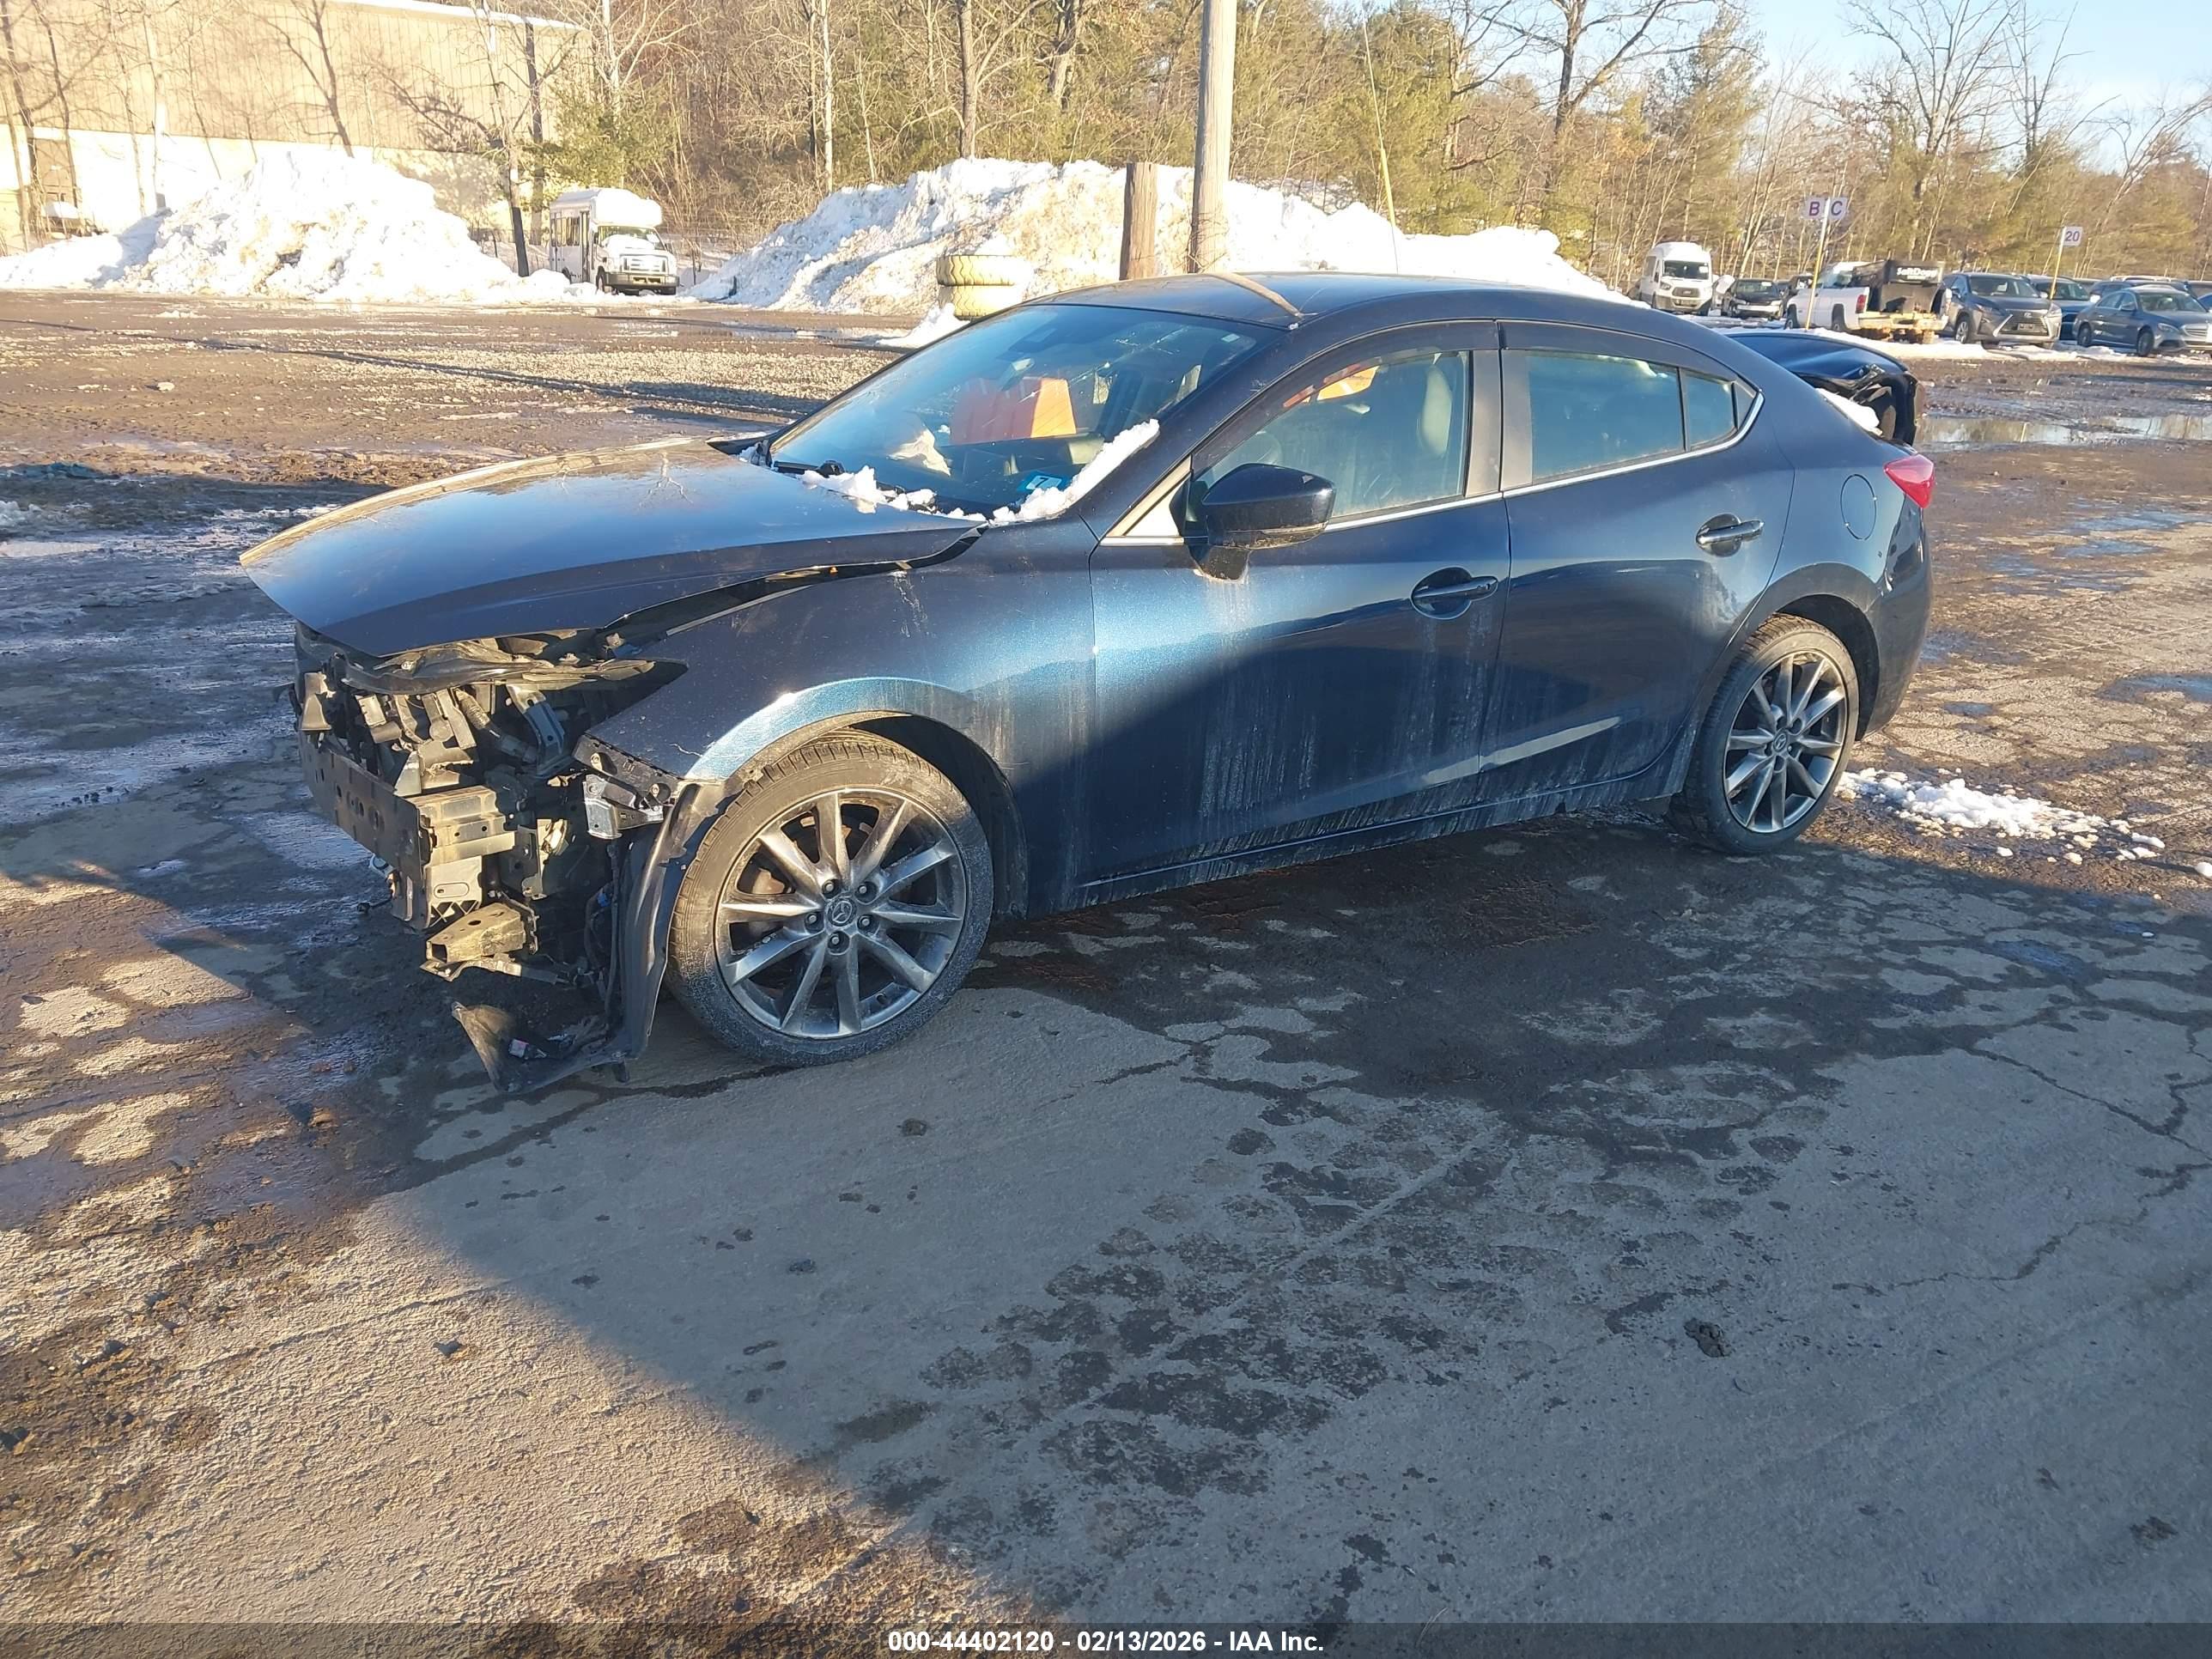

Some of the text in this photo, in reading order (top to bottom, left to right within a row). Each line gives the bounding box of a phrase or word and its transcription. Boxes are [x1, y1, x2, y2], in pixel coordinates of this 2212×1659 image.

[1809, 201, 1820, 216] B
[1831, 201, 1843, 216] C
[2065, 230, 2080, 241] 20
[1035, 477, 1048, 488] 7
